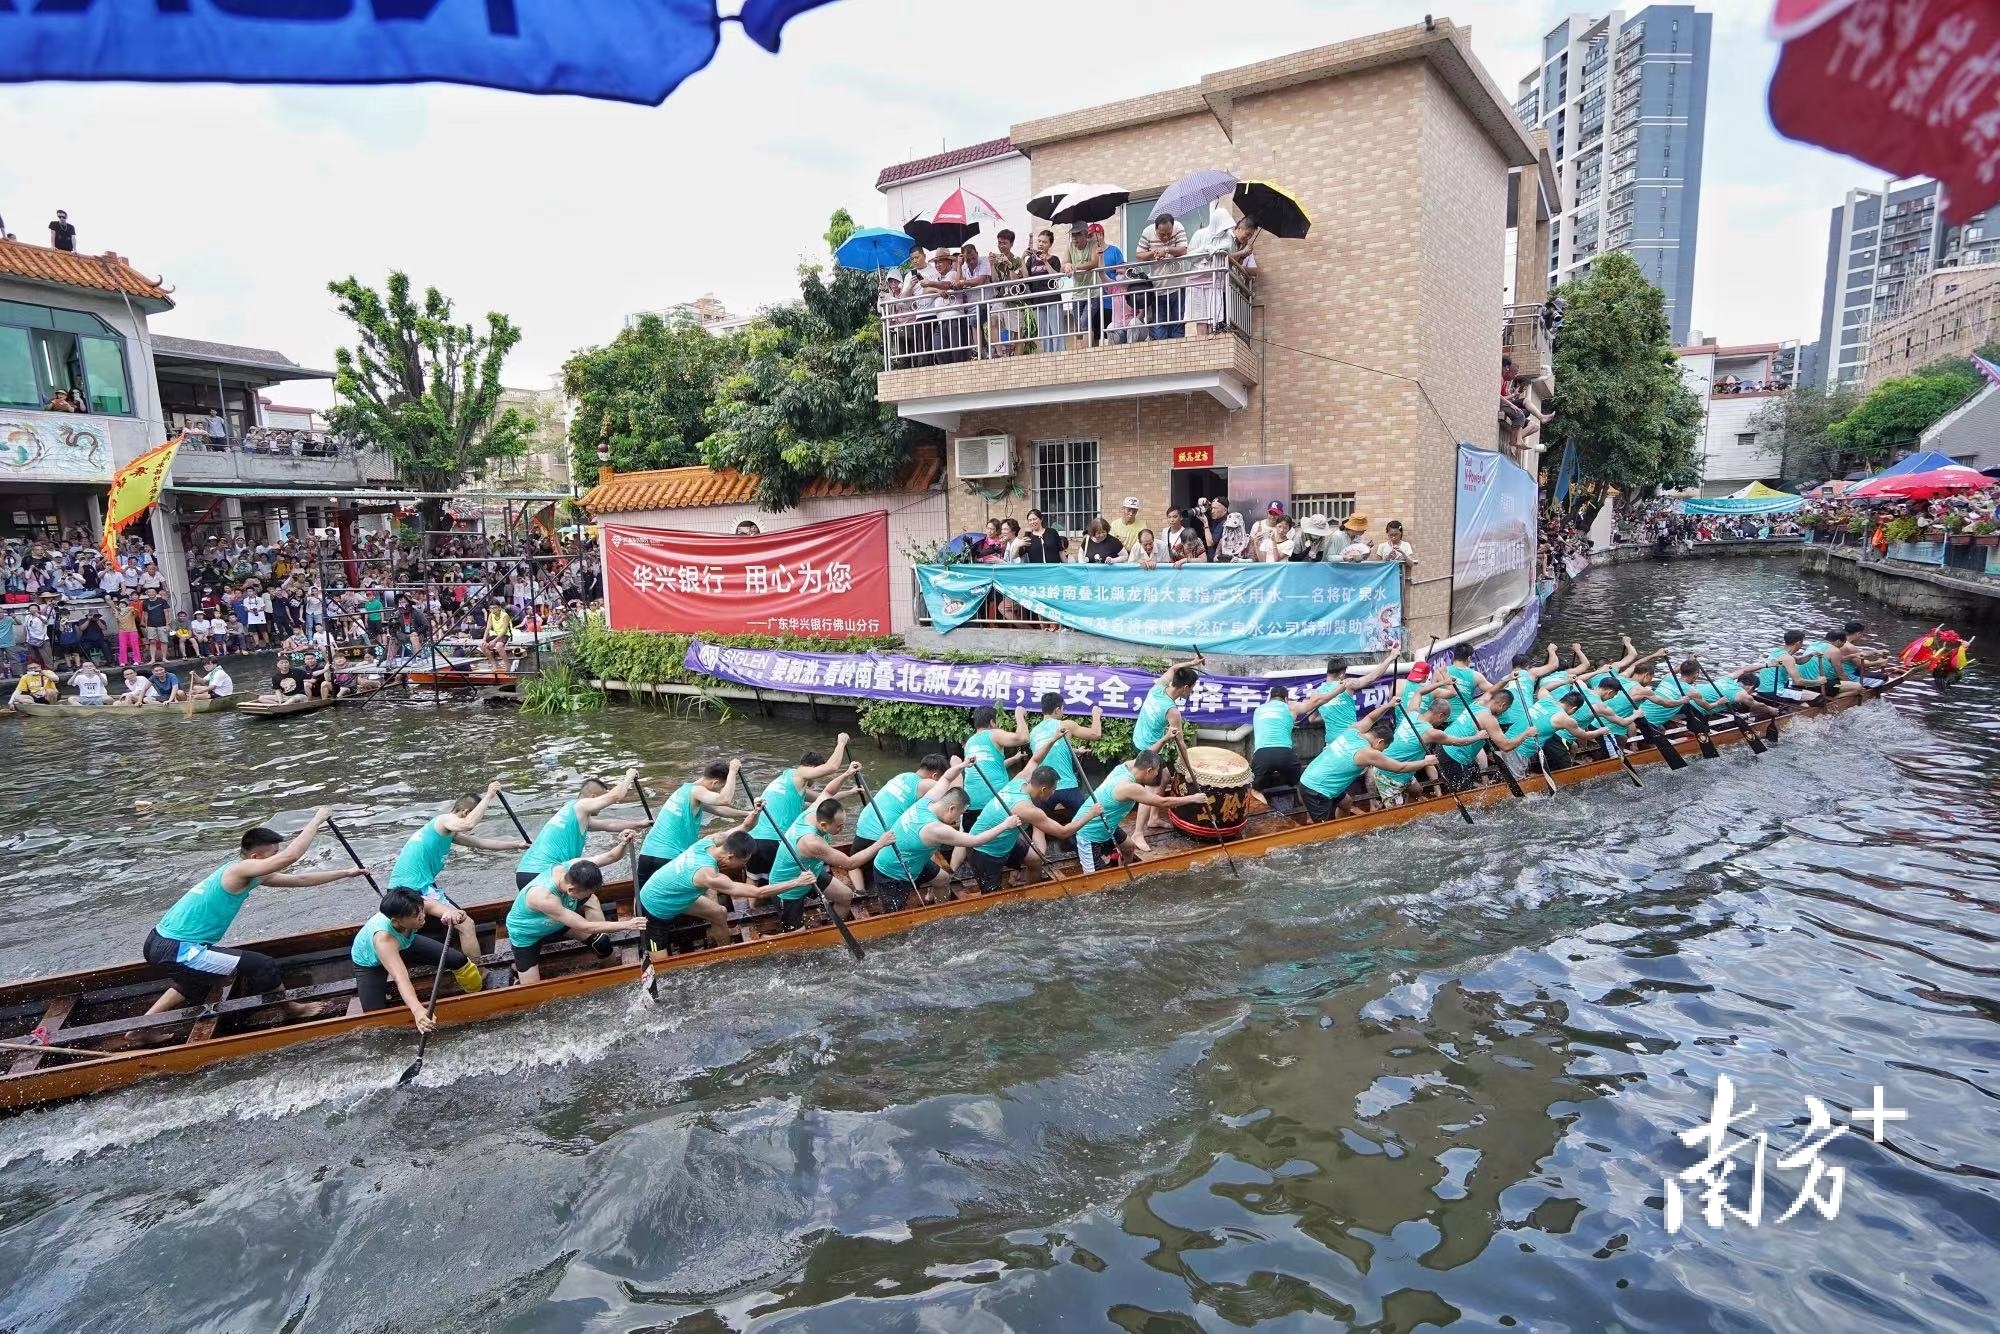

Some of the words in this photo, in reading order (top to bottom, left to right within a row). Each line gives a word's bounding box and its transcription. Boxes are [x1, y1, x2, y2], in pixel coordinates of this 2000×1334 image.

[633, 564, 726, 593] 华兴银行
[745, 561, 853, 594] 用心为您
[723, 648, 770, 670] SIGLEN
